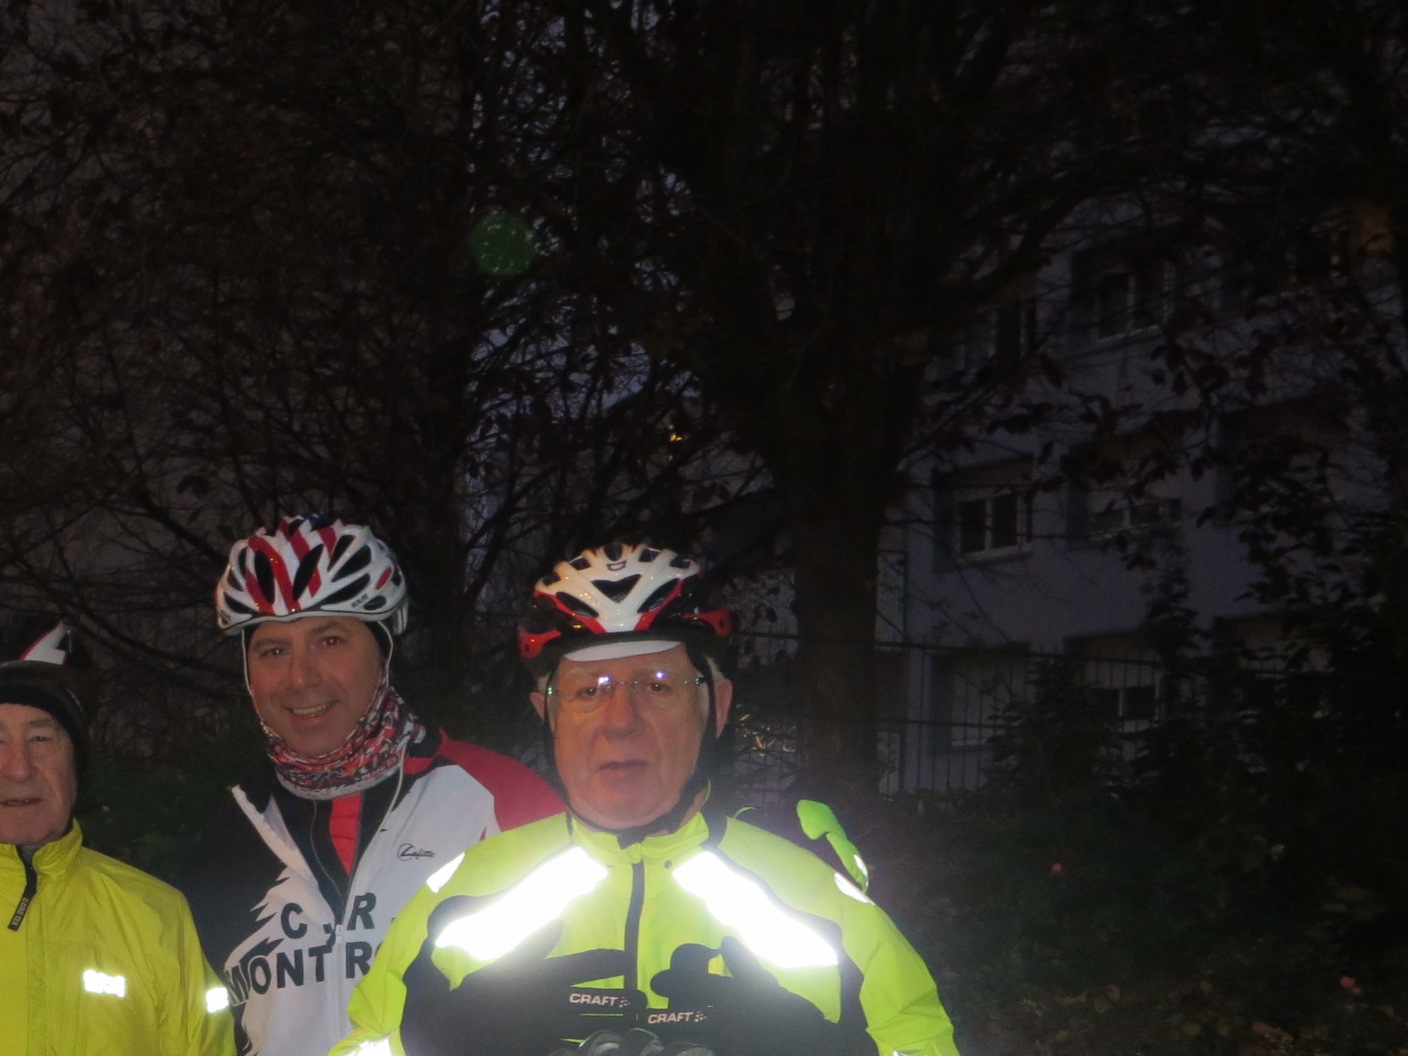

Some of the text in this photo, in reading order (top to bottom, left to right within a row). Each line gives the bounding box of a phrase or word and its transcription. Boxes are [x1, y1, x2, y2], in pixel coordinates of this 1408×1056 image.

[225, 941, 383, 1004] MONTR
[569, 993, 619, 1007] CRAFT
[647, 1011, 694, 1024] CRAFT
